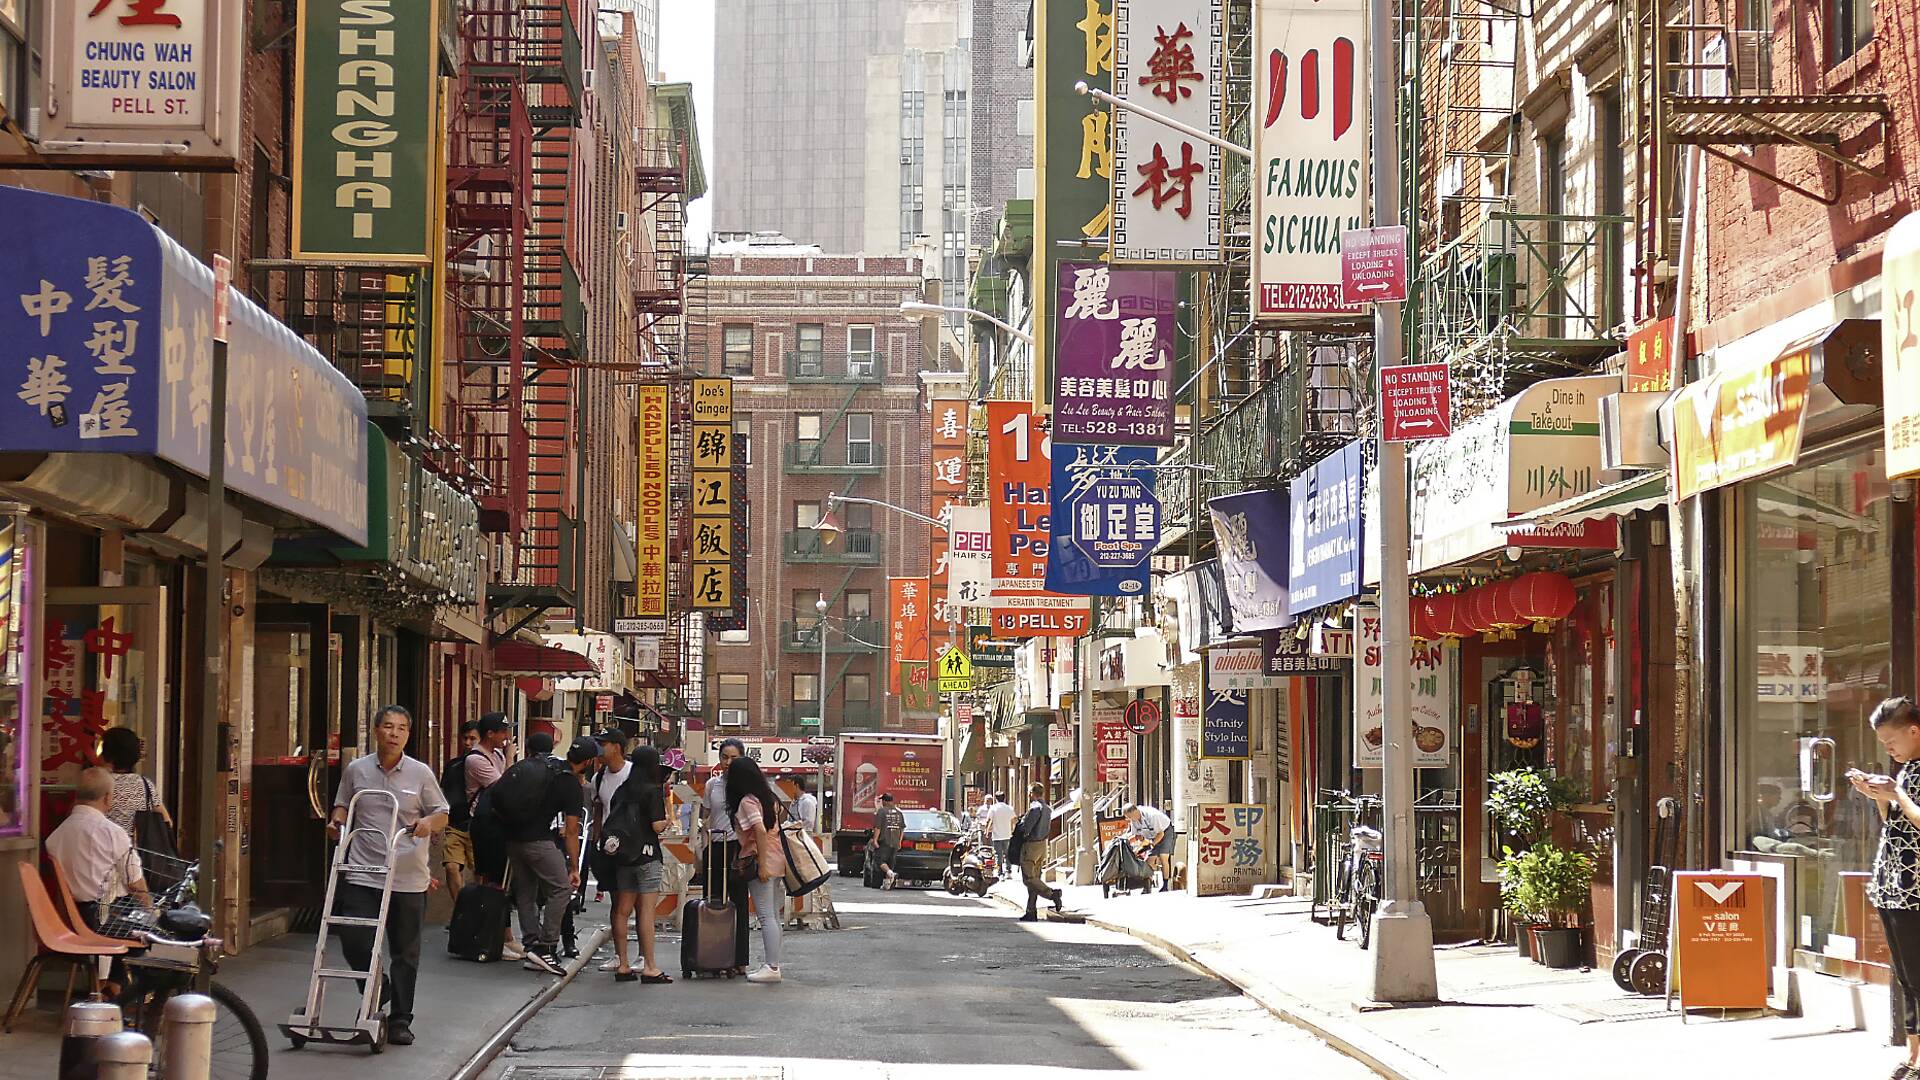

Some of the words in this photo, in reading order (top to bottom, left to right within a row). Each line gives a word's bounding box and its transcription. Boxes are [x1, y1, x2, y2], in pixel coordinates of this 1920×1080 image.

[85, 41, 146, 63] CHUNG
[154, 42, 193, 63] WAH
[80, 69, 141, 90] BEAUTY
[148, 70, 197, 91] SALON
[1264, 36, 1355, 142] 川
[111, 97, 156, 115] PELL
[163, 98, 190, 115] ST.
[331, 0, 399, 239] SHANGHAI
[1132, 21, 1205, 220] 藥材
[1266, 157, 1361, 199] FAMOUS
[1360, 234, 1401, 247] STANDING
[1347, 251, 1371, 260] EXCEPT
[1374, 249, 1398, 258] TRUCKS
[1351, 260, 1384, 270] LOADING
[1351, 269, 1395, 281] UNLOADING
[1263, 284, 1359, 310] TEL:212-233-3
[16, 278, 74, 417] 中華
[84, 255, 142, 438] 髮型屋
[1385, 373, 1398, 385] NO
[1401, 370, 1444, 383] STANDING
[700, 383, 724, 397] Joe's
[1060, 376, 1168, 400] 美容美髮中心
[1388, 387, 1413, 397] EXCEPT
[1415, 386, 1442, 395] TRUCKS
[1392, 397, 1427, 407] LOADING
[1552, 388, 1574, 405] Dine
[1576, 388, 1585, 405] in
[695, 401, 730, 418] Ginger
[1091, 403, 1115, 418] Beauty
[1125, 404, 1143, 418] Hair
[1144, 404, 1167, 419] Salon
[1393, 407, 1439, 418] UNLOADING
[1545, 400, 1552, 414] &
[1531, 412, 1552, 430] Take
[1553, 414, 1573, 430] out
[1526, 465, 1592, 499] 川外川
[1096, 485, 1107, 499] YU
[1108, 485, 1119, 499] ZU
[1121, 485, 1141, 499] TANG
[643, 482, 662, 541] NOODLES
[695, 428, 730, 604] 錦江飯店
[1080, 502, 1155, 541] 御足堂
[1094, 541, 1120, 551] Foot
[1120, 541, 1142, 552] Spa
[953, 551, 977, 559] HAIR
[642, 544, 662, 614] 中華拉麵
[997, 579, 1031, 588] JAPANESE
[1007, 598, 1036, 607] KERATIN
[1037, 598, 1074, 608] TREATMENT
[1000, 614, 1016, 630] 18
[1019, 614, 1060, 630] PELL
[1063, 615, 1085, 630] ST
[942, 680, 968, 689] AHEAD
[1131, 700, 1153, 722] 18
[1205, 717, 1244, 729] Infinity
[1204, 731, 1229, 744] Style
[1230, 731, 1248, 743] Inc.
[893, 778, 928, 787] MOUTAI
[1200, 807, 1232, 866] 天河
[1231, 807, 1264, 867] 印務
[1233, 867, 1262, 876] PRINTING
[1221, 876, 1241, 884] CORP
[1714, 911, 1740, 921] salon
